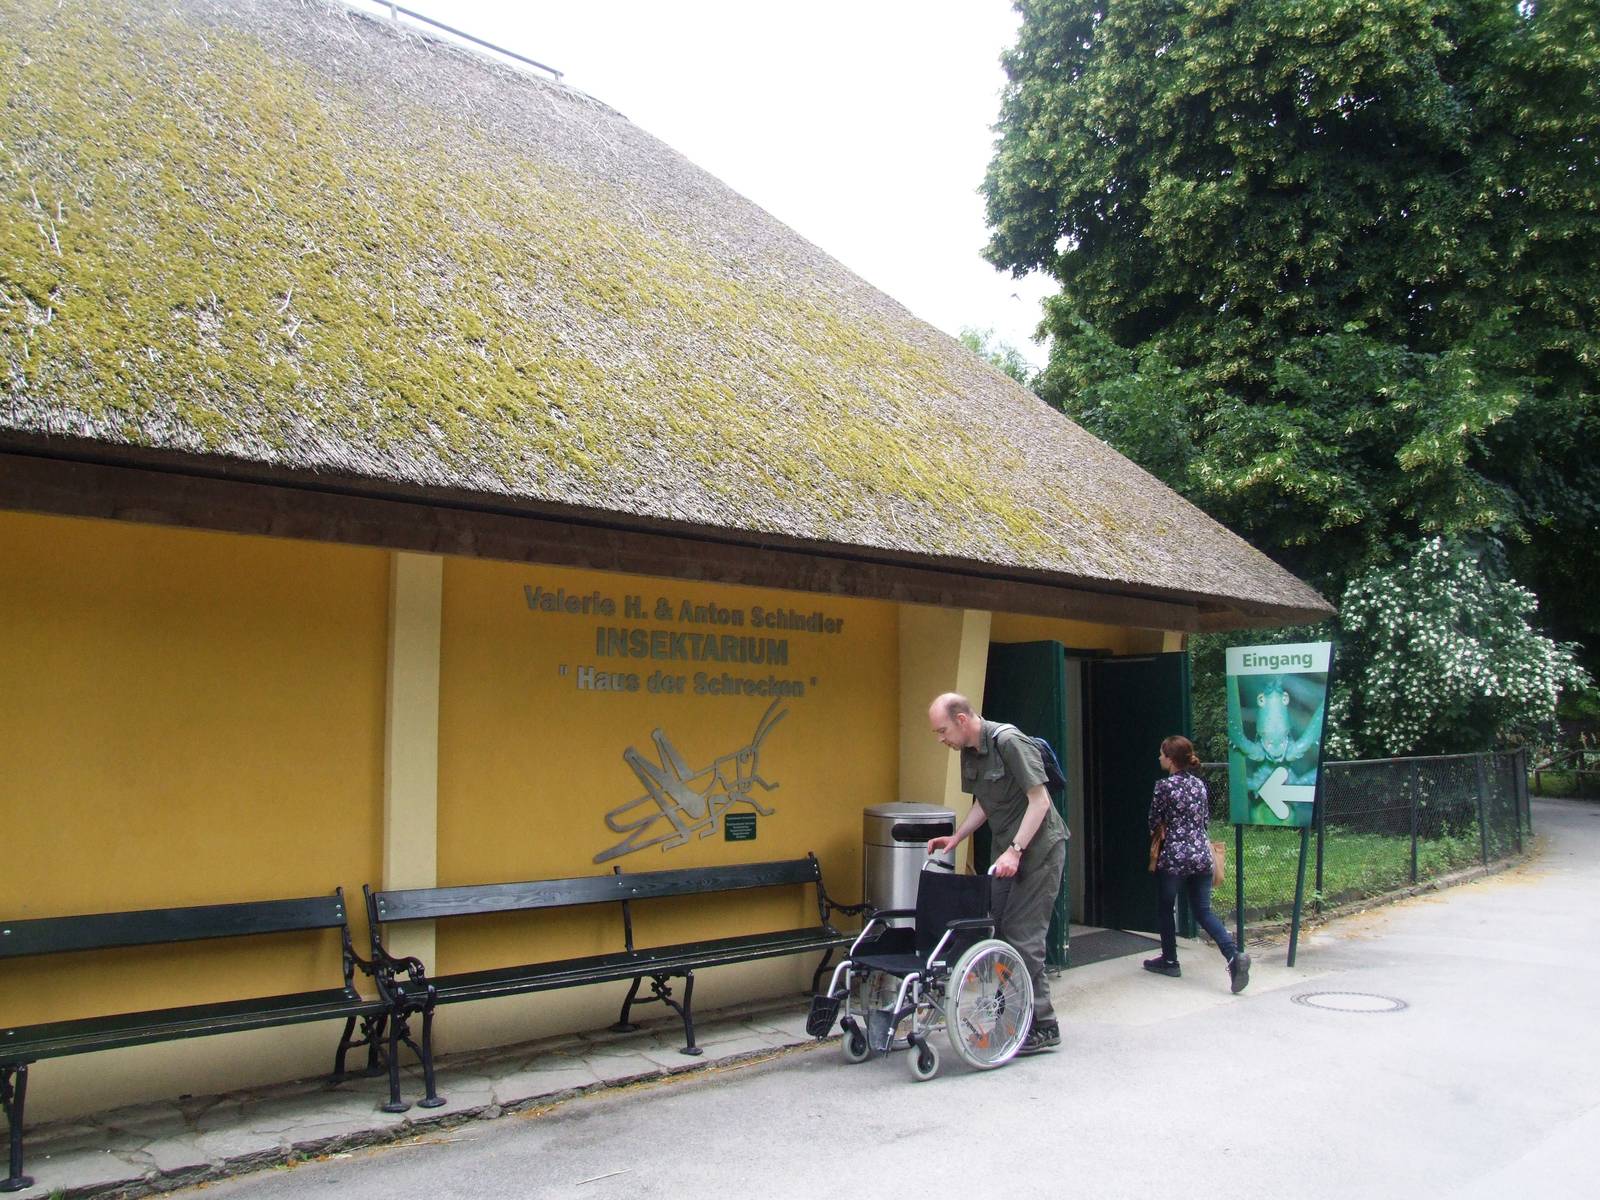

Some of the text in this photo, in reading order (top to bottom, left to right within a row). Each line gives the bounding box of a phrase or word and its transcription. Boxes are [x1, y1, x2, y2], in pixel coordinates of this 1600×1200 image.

[524, 584, 844, 634] Valerie H. & Anton Schindler
[596, 627, 788, 666] INSEKTARIUM
[1242, 653, 1313, 670] Eingang
[647, 670, 686, 694] der
